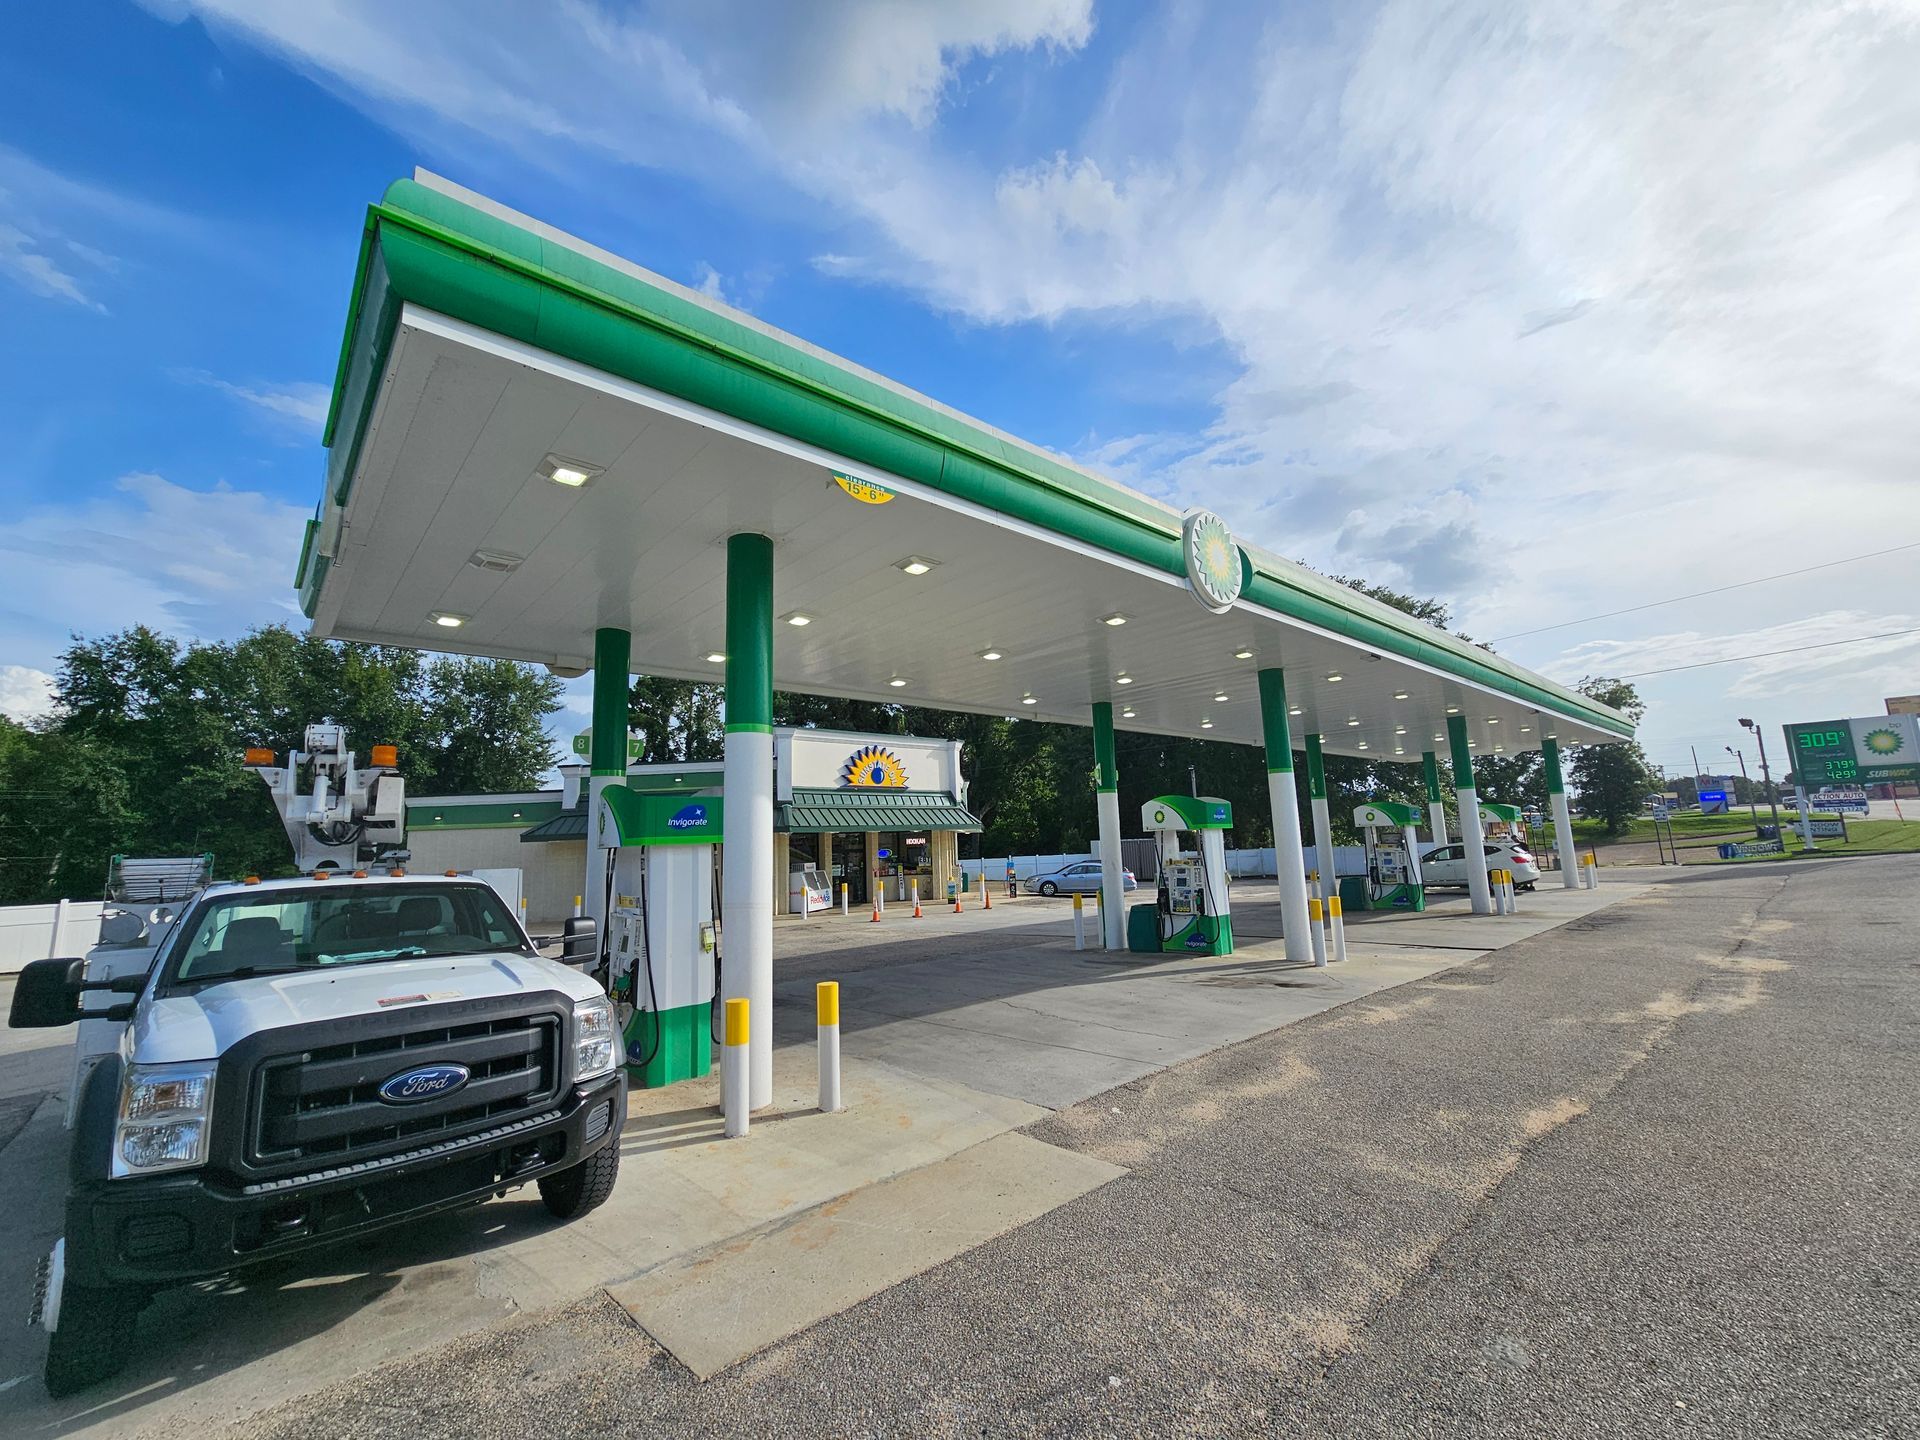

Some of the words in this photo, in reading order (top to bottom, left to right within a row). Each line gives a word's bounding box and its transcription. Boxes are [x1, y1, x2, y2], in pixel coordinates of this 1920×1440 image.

[845, 475, 885, 492] clearance
[577, 738, 585, 749] 8
[633, 743, 641, 753] 7
[1866, 768, 1915, 778] SUBWAY
[668, 817, 708, 828] Invigorate
[402, 1072, 448, 1096] Ford
